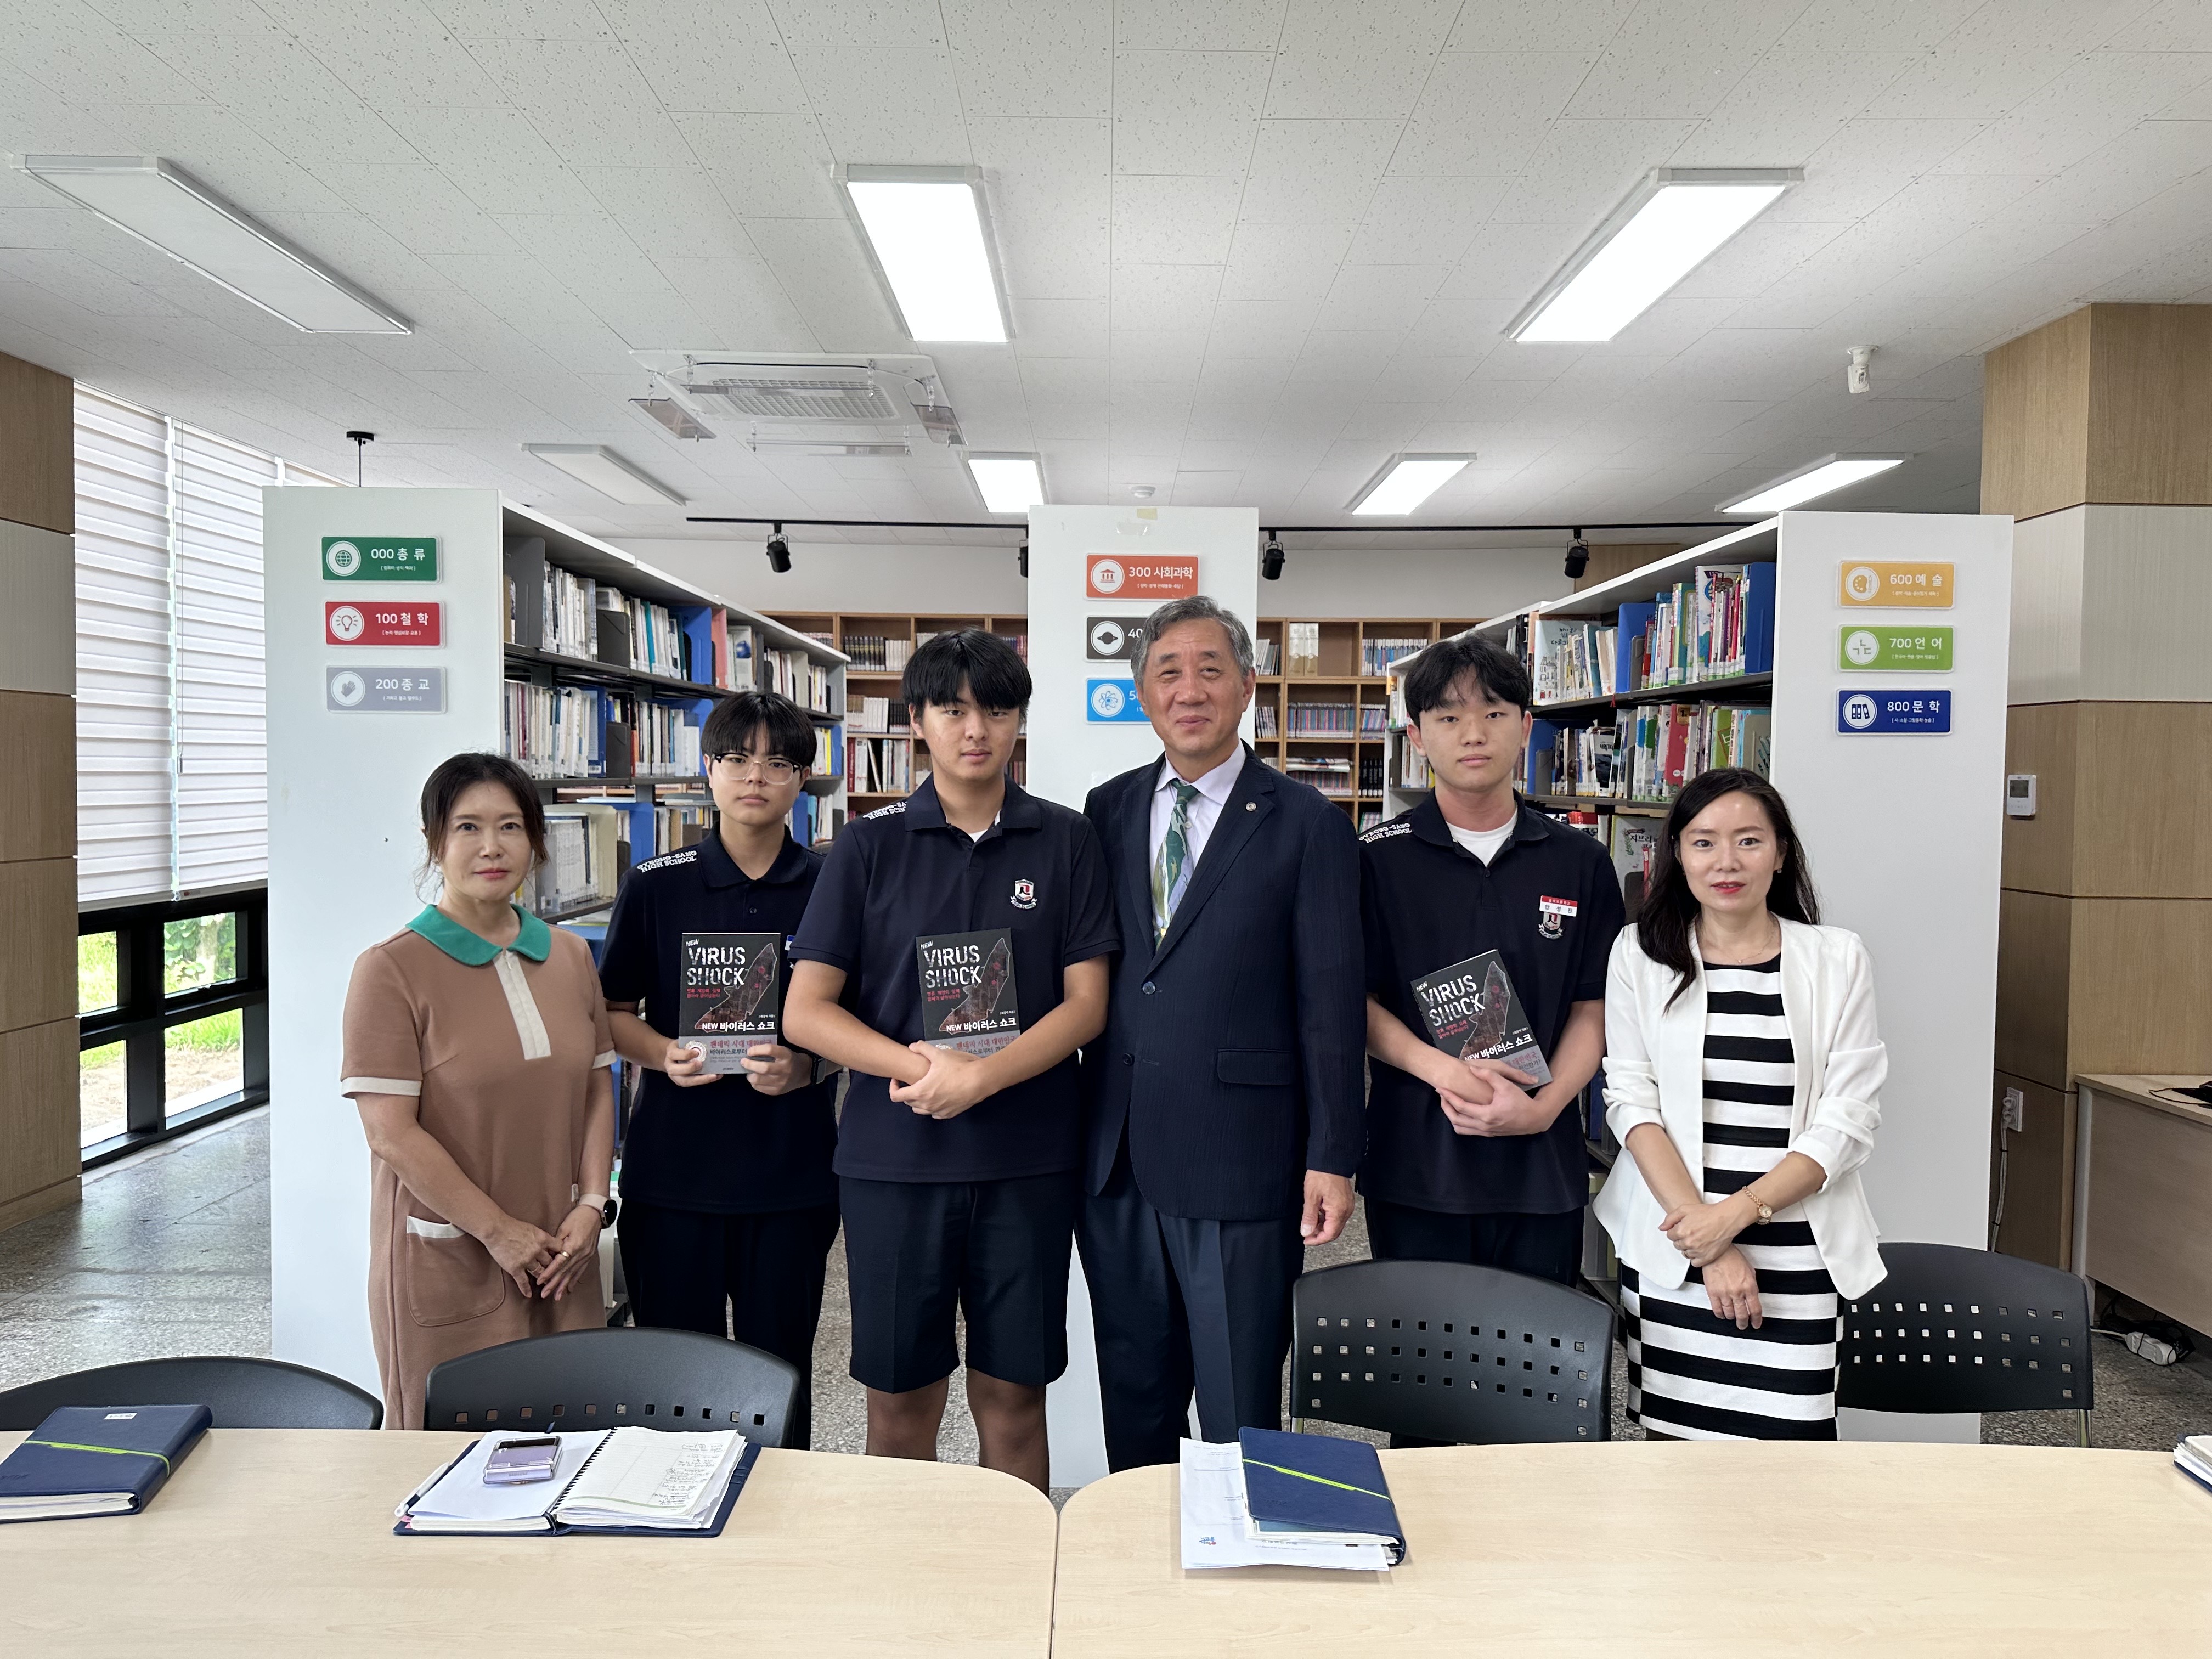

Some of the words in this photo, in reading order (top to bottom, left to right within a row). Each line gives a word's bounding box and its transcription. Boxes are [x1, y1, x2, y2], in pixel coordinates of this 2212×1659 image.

[371, 548, 394, 559] 000
[1128, 566, 1151, 577] 300
[1154, 566, 1193, 579] 사회과학
[1890, 574, 1912, 585] 600
[375, 613, 398, 624] 100
[1128, 628, 1143, 639] 40
[1889, 638, 1912, 648] 700
[375, 679, 398, 689] 200
[1887, 701, 1910, 712] 800
[1358, 822, 1411, 841] GYEONG-SANG
[1364, 833, 1385, 844] HIGH
[1385, 827, 1413, 837] SCHOOL
[1630, 834, 1652, 843] 지브리
[637, 850, 697, 870] GYEONG-SANG
[641, 862, 664, 873] HIGH
[664, 856, 697, 866] SCHOOL
[686, 939, 699, 947] NEW
[920, 940, 934, 950] NEW
[688, 947, 746, 966] VIRUS
[923, 945, 980, 968] VIRUS
[686, 967, 744, 986] SHOCK
[925, 965, 982, 989] SHOCK
[1416, 981, 1428, 992] NEW
[1421, 974, 1477, 1008] VIRUS
[1429, 993, 1486, 1027] SHOCK
[720, 1022, 755, 1032] 바이러스
[757, 1021, 775, 1030] 쇼크
[946, 1024, 962, 1032] NEW
[963, 1019, 998, 1032] 바이러스
[1000, 1017, 1017, 1027] 쇼크
[710, 1040, 730, 1048] 팬데믹
[732, 1040, 744, 1048] 시대
[956, 1041, 975, 1050] 팬데믹
[978, 1039, 990, 1047] 시대
[1464, 1052, 1480, 1062] NEW
[1480, 1041, 1515, 1058] 바이러스
[1515, 1034, 1533, 1047] 쇼크
